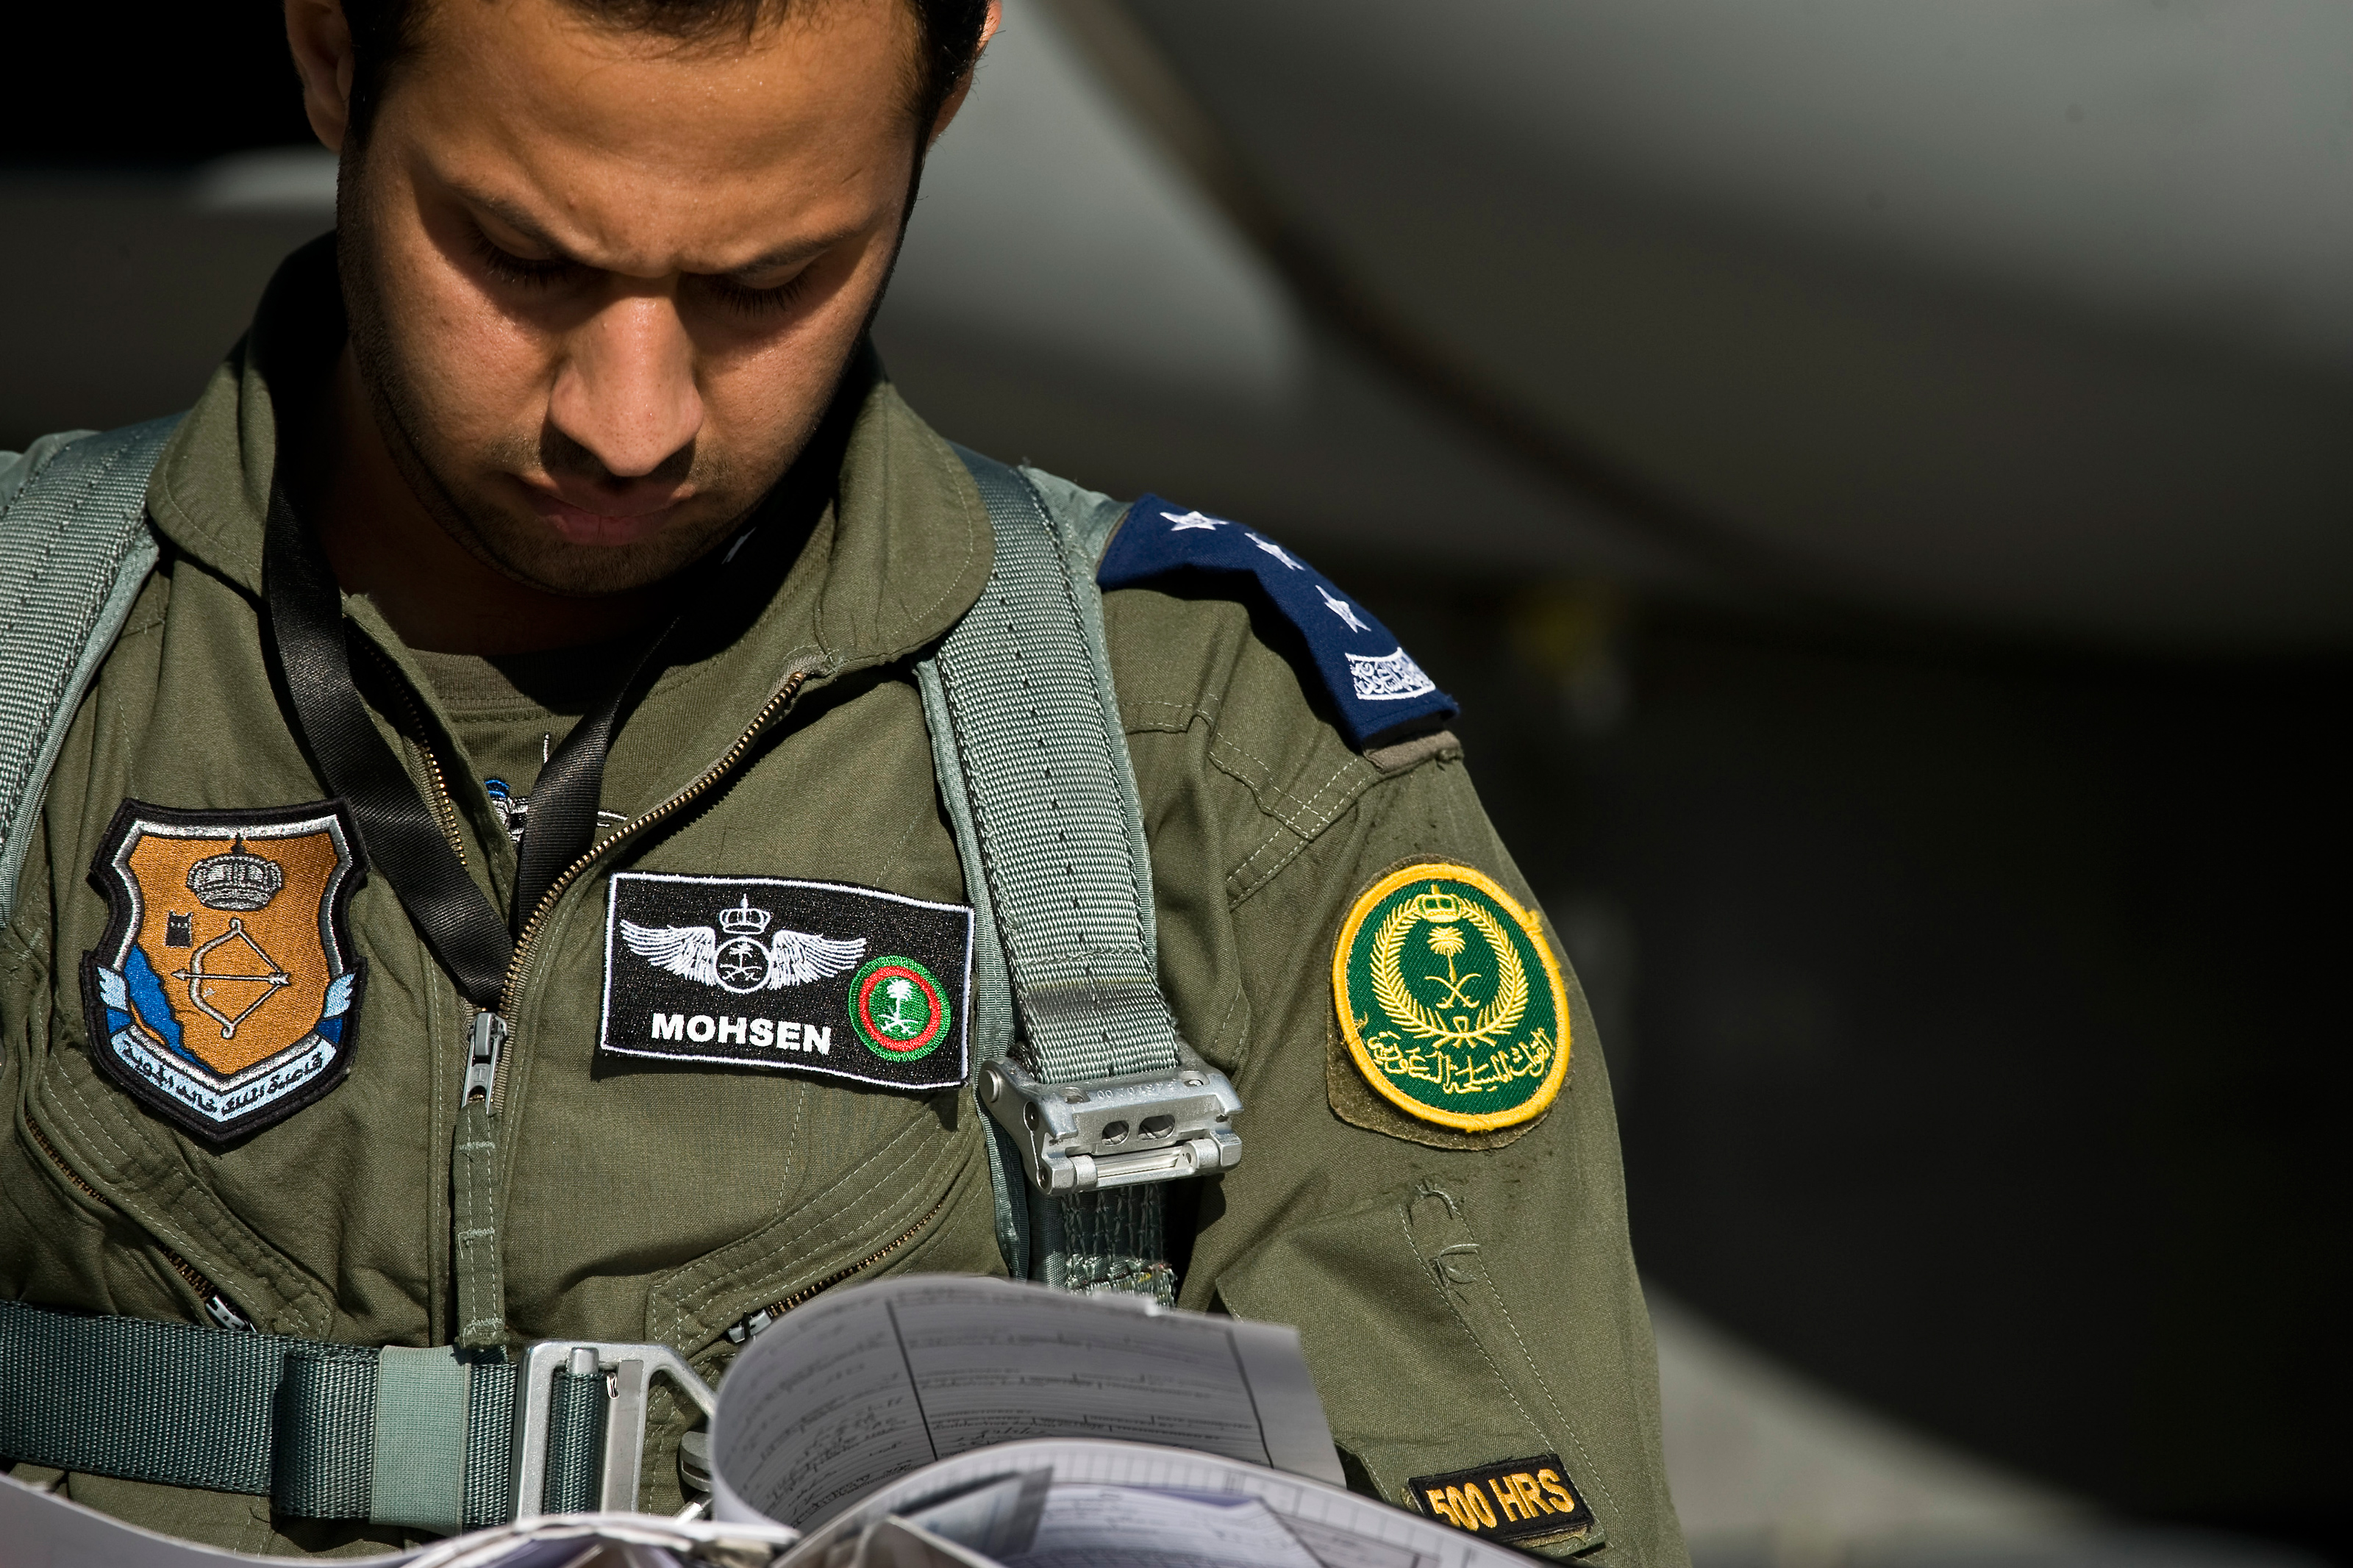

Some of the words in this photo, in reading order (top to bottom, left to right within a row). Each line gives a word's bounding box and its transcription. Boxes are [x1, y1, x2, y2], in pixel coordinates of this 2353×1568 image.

[651, 1013, 832, 1056] MOHSEN
[267, 1052, 323, 1094] قاعدة
[176, 1084, 218, 1113] خالد
[221, 1084, 265, 1116] الملك
[1426, 1482, 1497, 1531] 500
[1488, 1469, 1575, 1522] HRS
